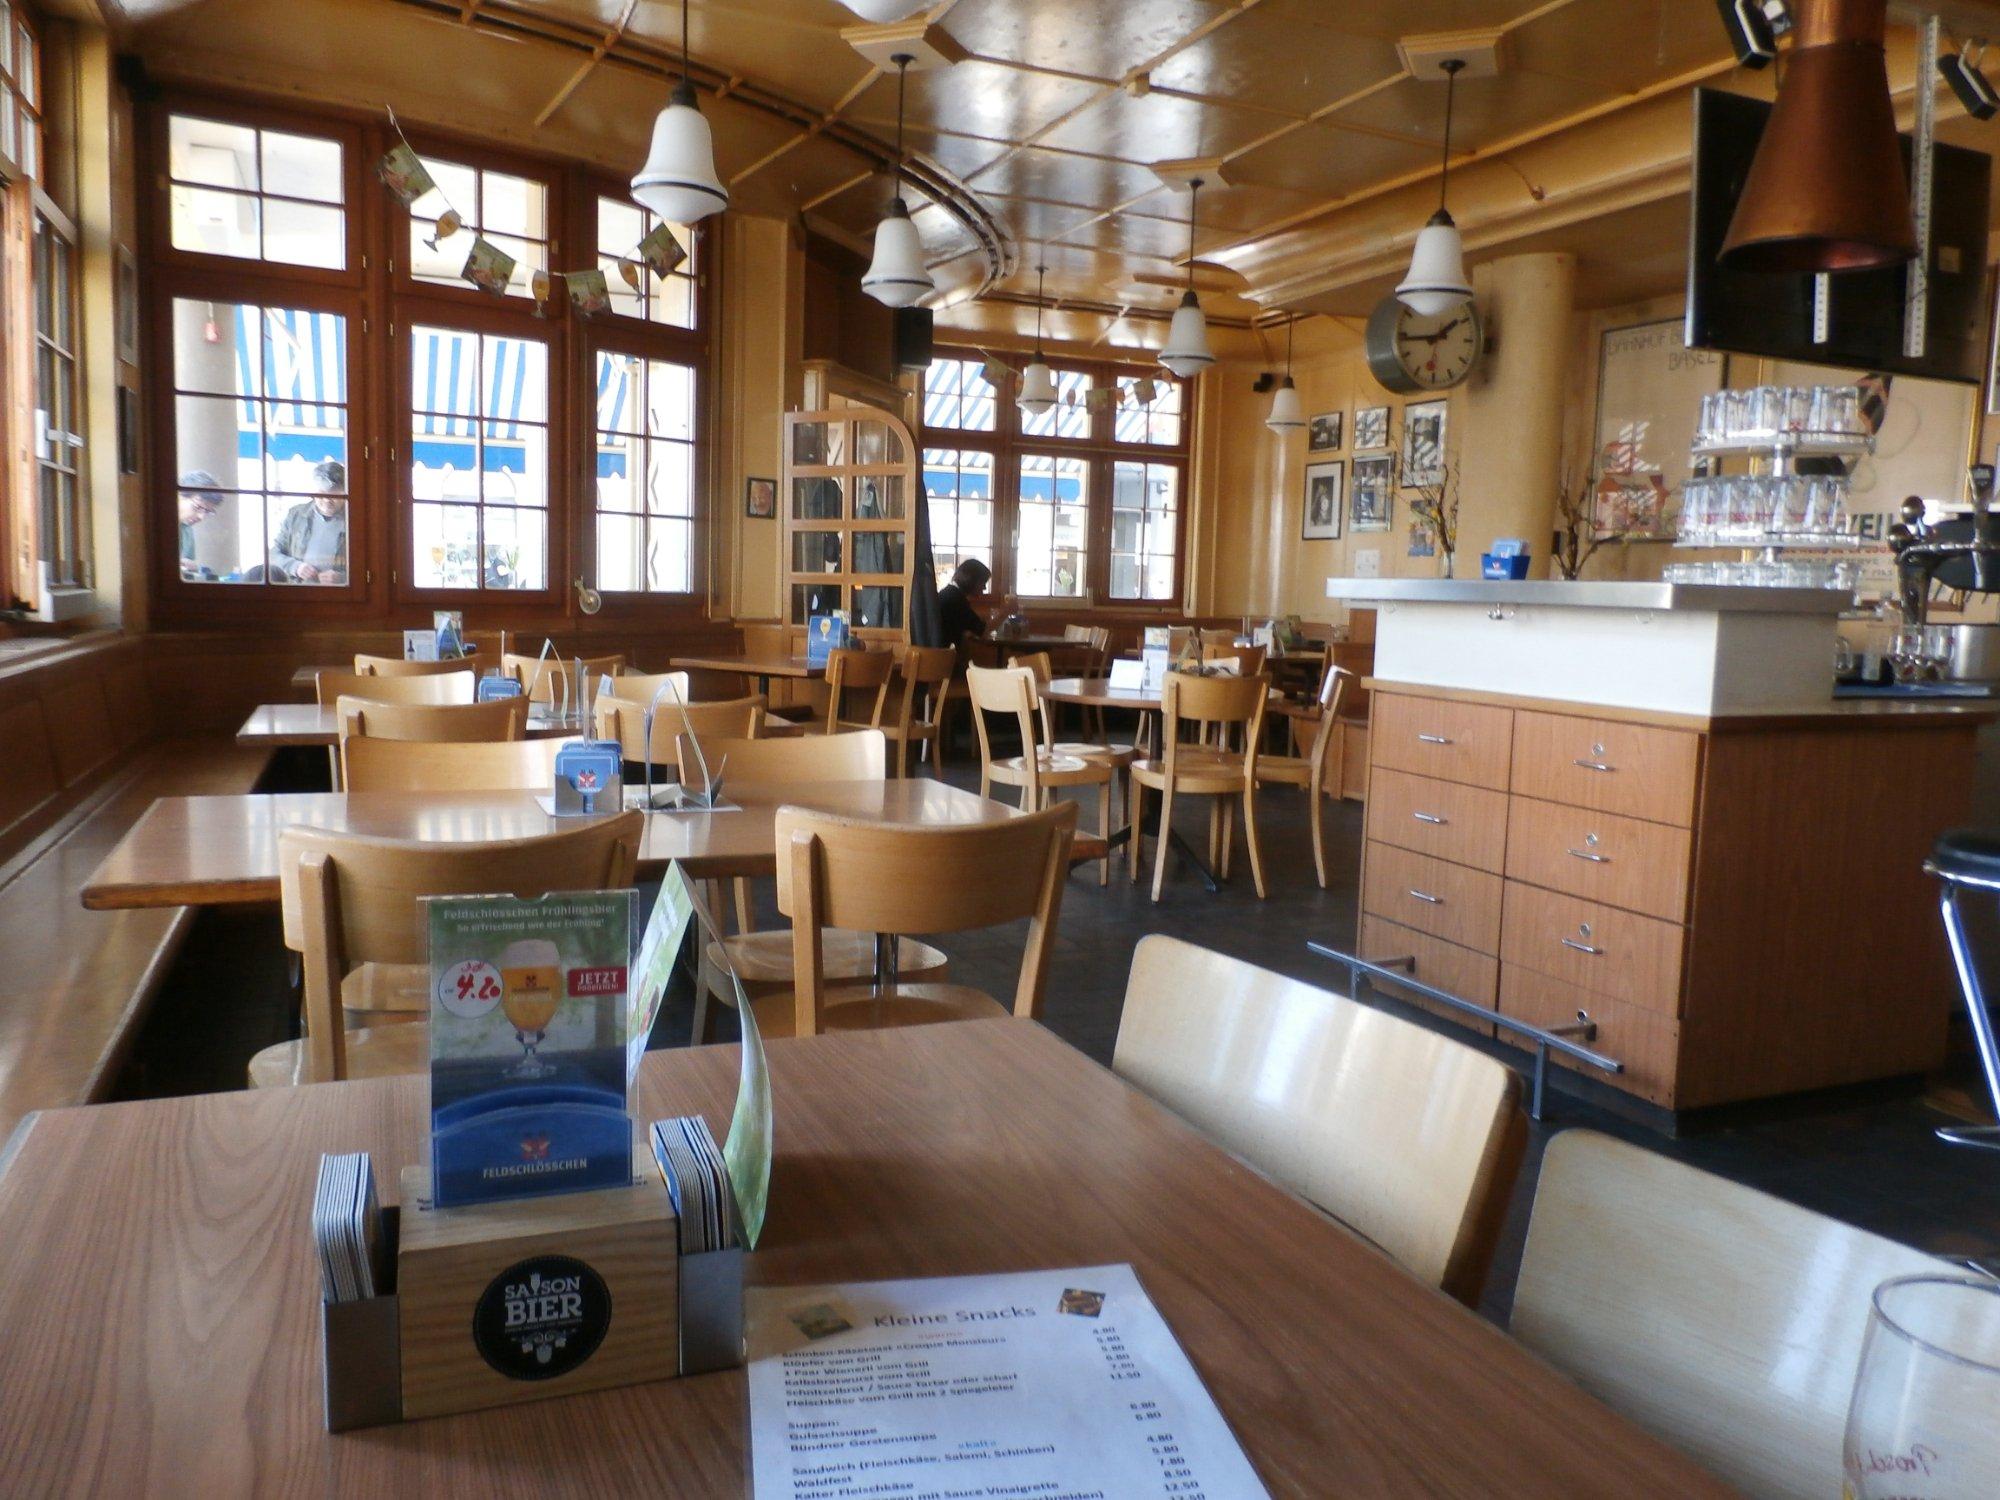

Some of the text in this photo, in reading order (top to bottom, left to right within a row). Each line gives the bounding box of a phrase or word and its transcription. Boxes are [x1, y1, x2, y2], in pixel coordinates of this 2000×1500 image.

[443, 905, 539, 919] Feldschlösschen
[578, 971, 619, 985] JETZT
[483, 1158, 588, 1179] FELDSCHLÖSSCHEN
[504, 1292, 583, 1327] BIER
[874, 1305, 1037, 1328] Kleine Snacks
[828, 1358, 855, 1367] vom
[857, 1354, 881, 1364] Grill
[794, 1368, 820, 1377] Paar
[877, 1363, 903, 1372] vom
[904, 1360, 929, 1370] Grill
[877, 1373, 903, 1382] vom
[906, 1370, 931, 1380] Grill
[877, 1381, 913, 1391] Sauce
[858, 1394, 886, 1403] vom
[888, 1390, 914, 1401] Grill
[916, 1388, 937, 1399] mit
[788, 1420, 840, 1431] Suppen:
[790, 1439, 845, 1452] Bündner
[792, 1463, 857, 1476] Sandwich
[994, 1444, 1056, 1459] Schinken)
[793, 1475, 853, 1489] Waldfest
[794, 1480, 915, 1500] Kalter Fleischkäse
[917, 1491, 941, 1500] mit
[944, 1486, 983, 1499] Sauce
[986, 1480, 1060, 1497] Vinaigrette
